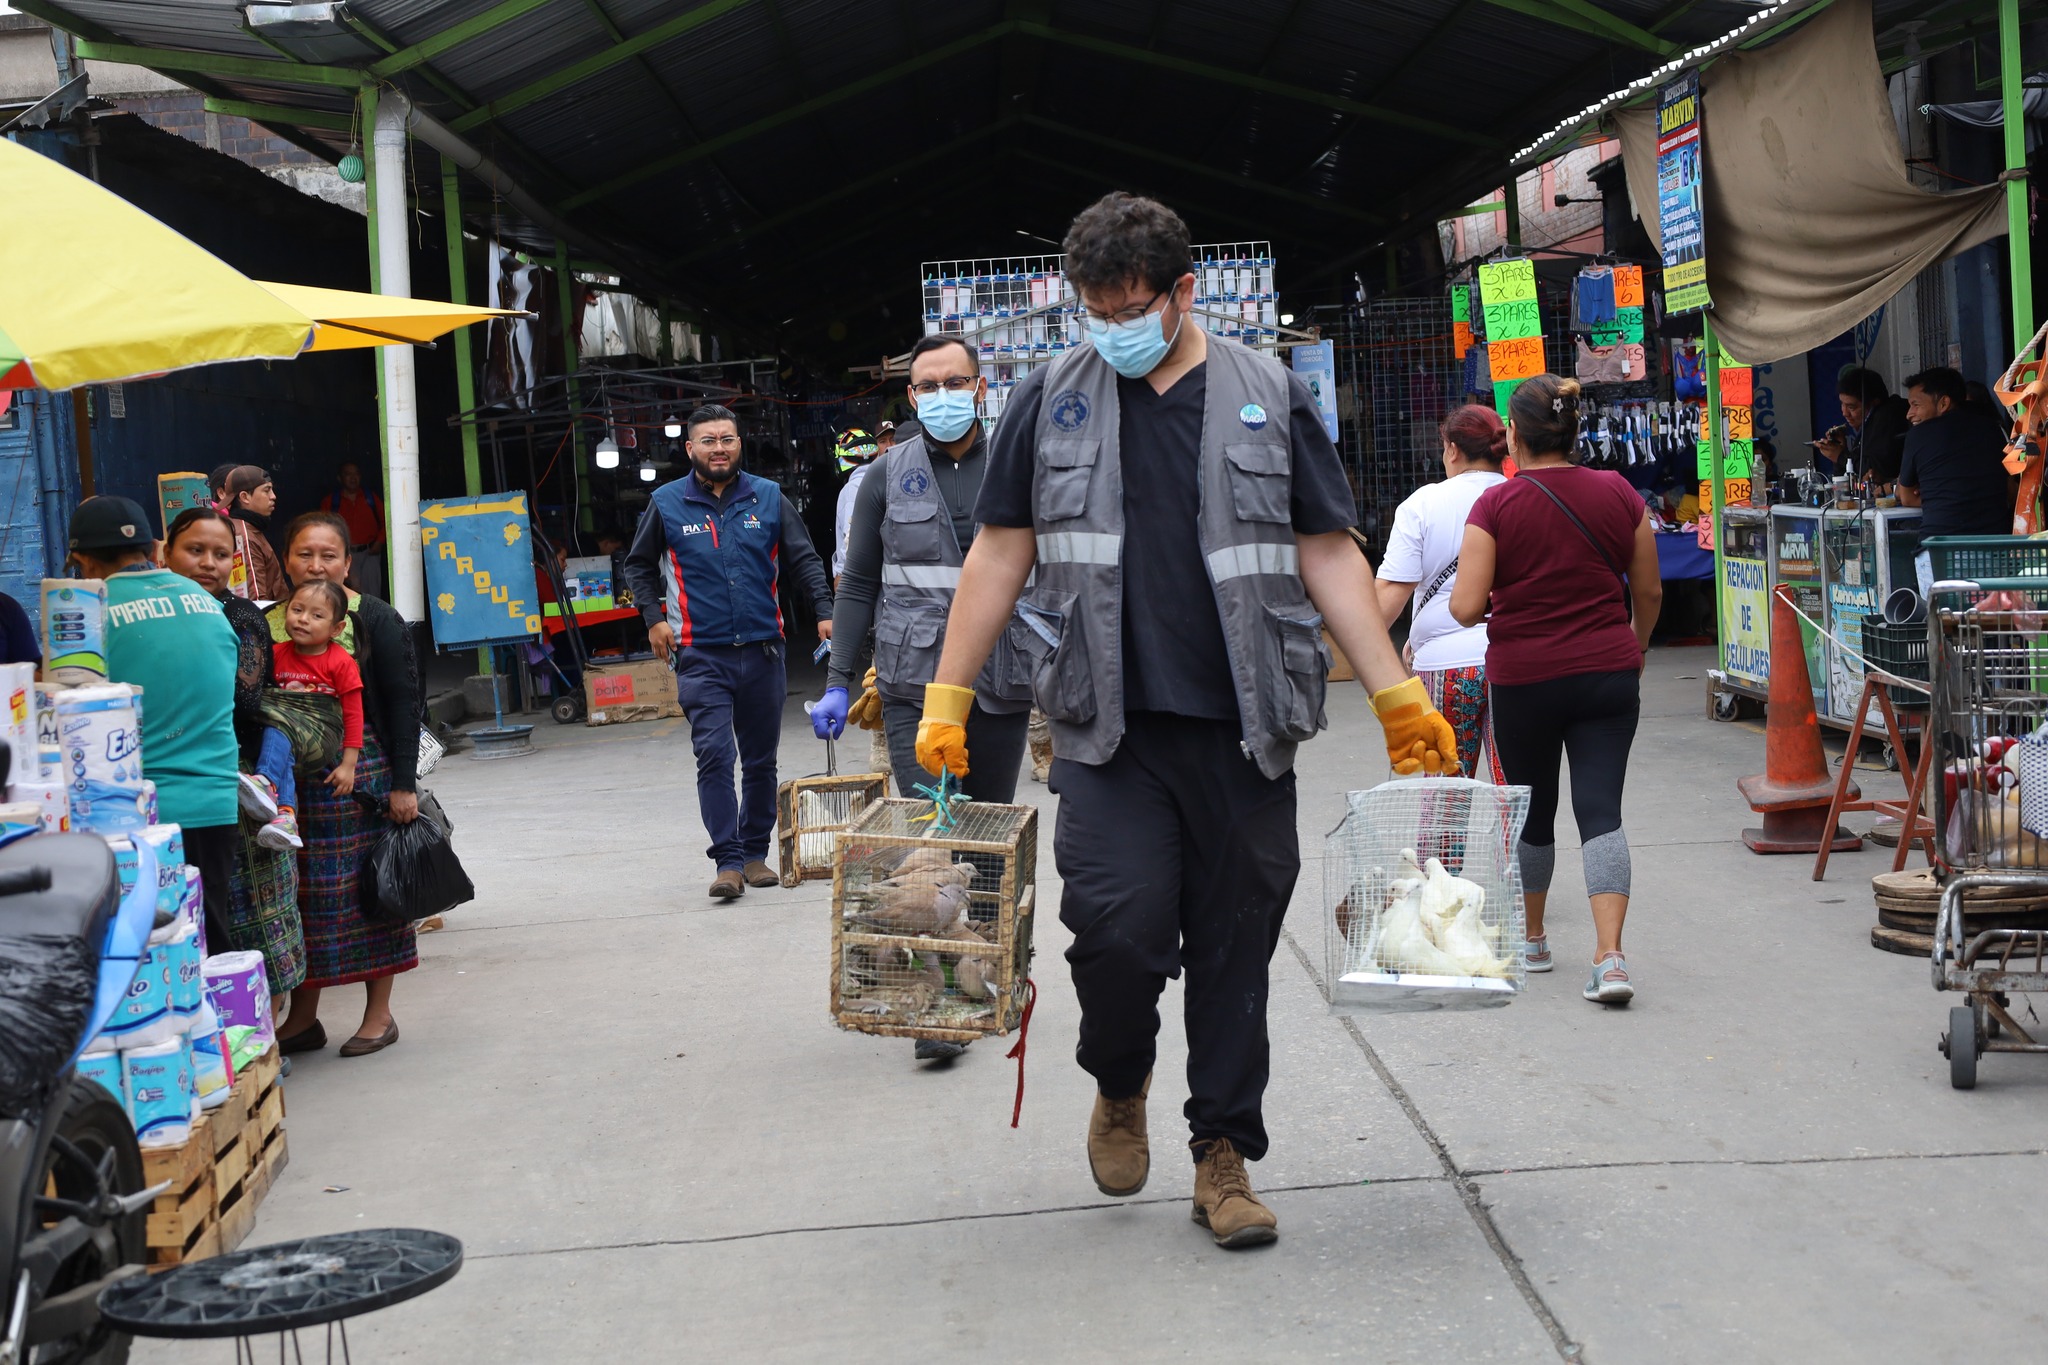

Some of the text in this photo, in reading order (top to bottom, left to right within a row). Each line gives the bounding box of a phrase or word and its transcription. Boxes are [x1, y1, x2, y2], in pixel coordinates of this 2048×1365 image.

[1483, 263, 1534, 285] 3 PARES
[1515, 282, 1525, 297] 6
[1620, 289, 1633, 303] 6
[1486, 302, 1539, 323] 3 PARES
[1519, 322, 1531, 337] 6
[1488, 339, 1539, 362] 3 PARES
[1518, 360, 1528, 373] 6
[1241, 414, 1267, 424] MAGA
[1726, 462, 1738, 475] 6
[1726, 560, 1765, 592] REPACION
[108, 596, 176, 628] MARCO
[1741, 604, 1752, 632] DE
[1726, 642, 1770, 680] CELULARES
